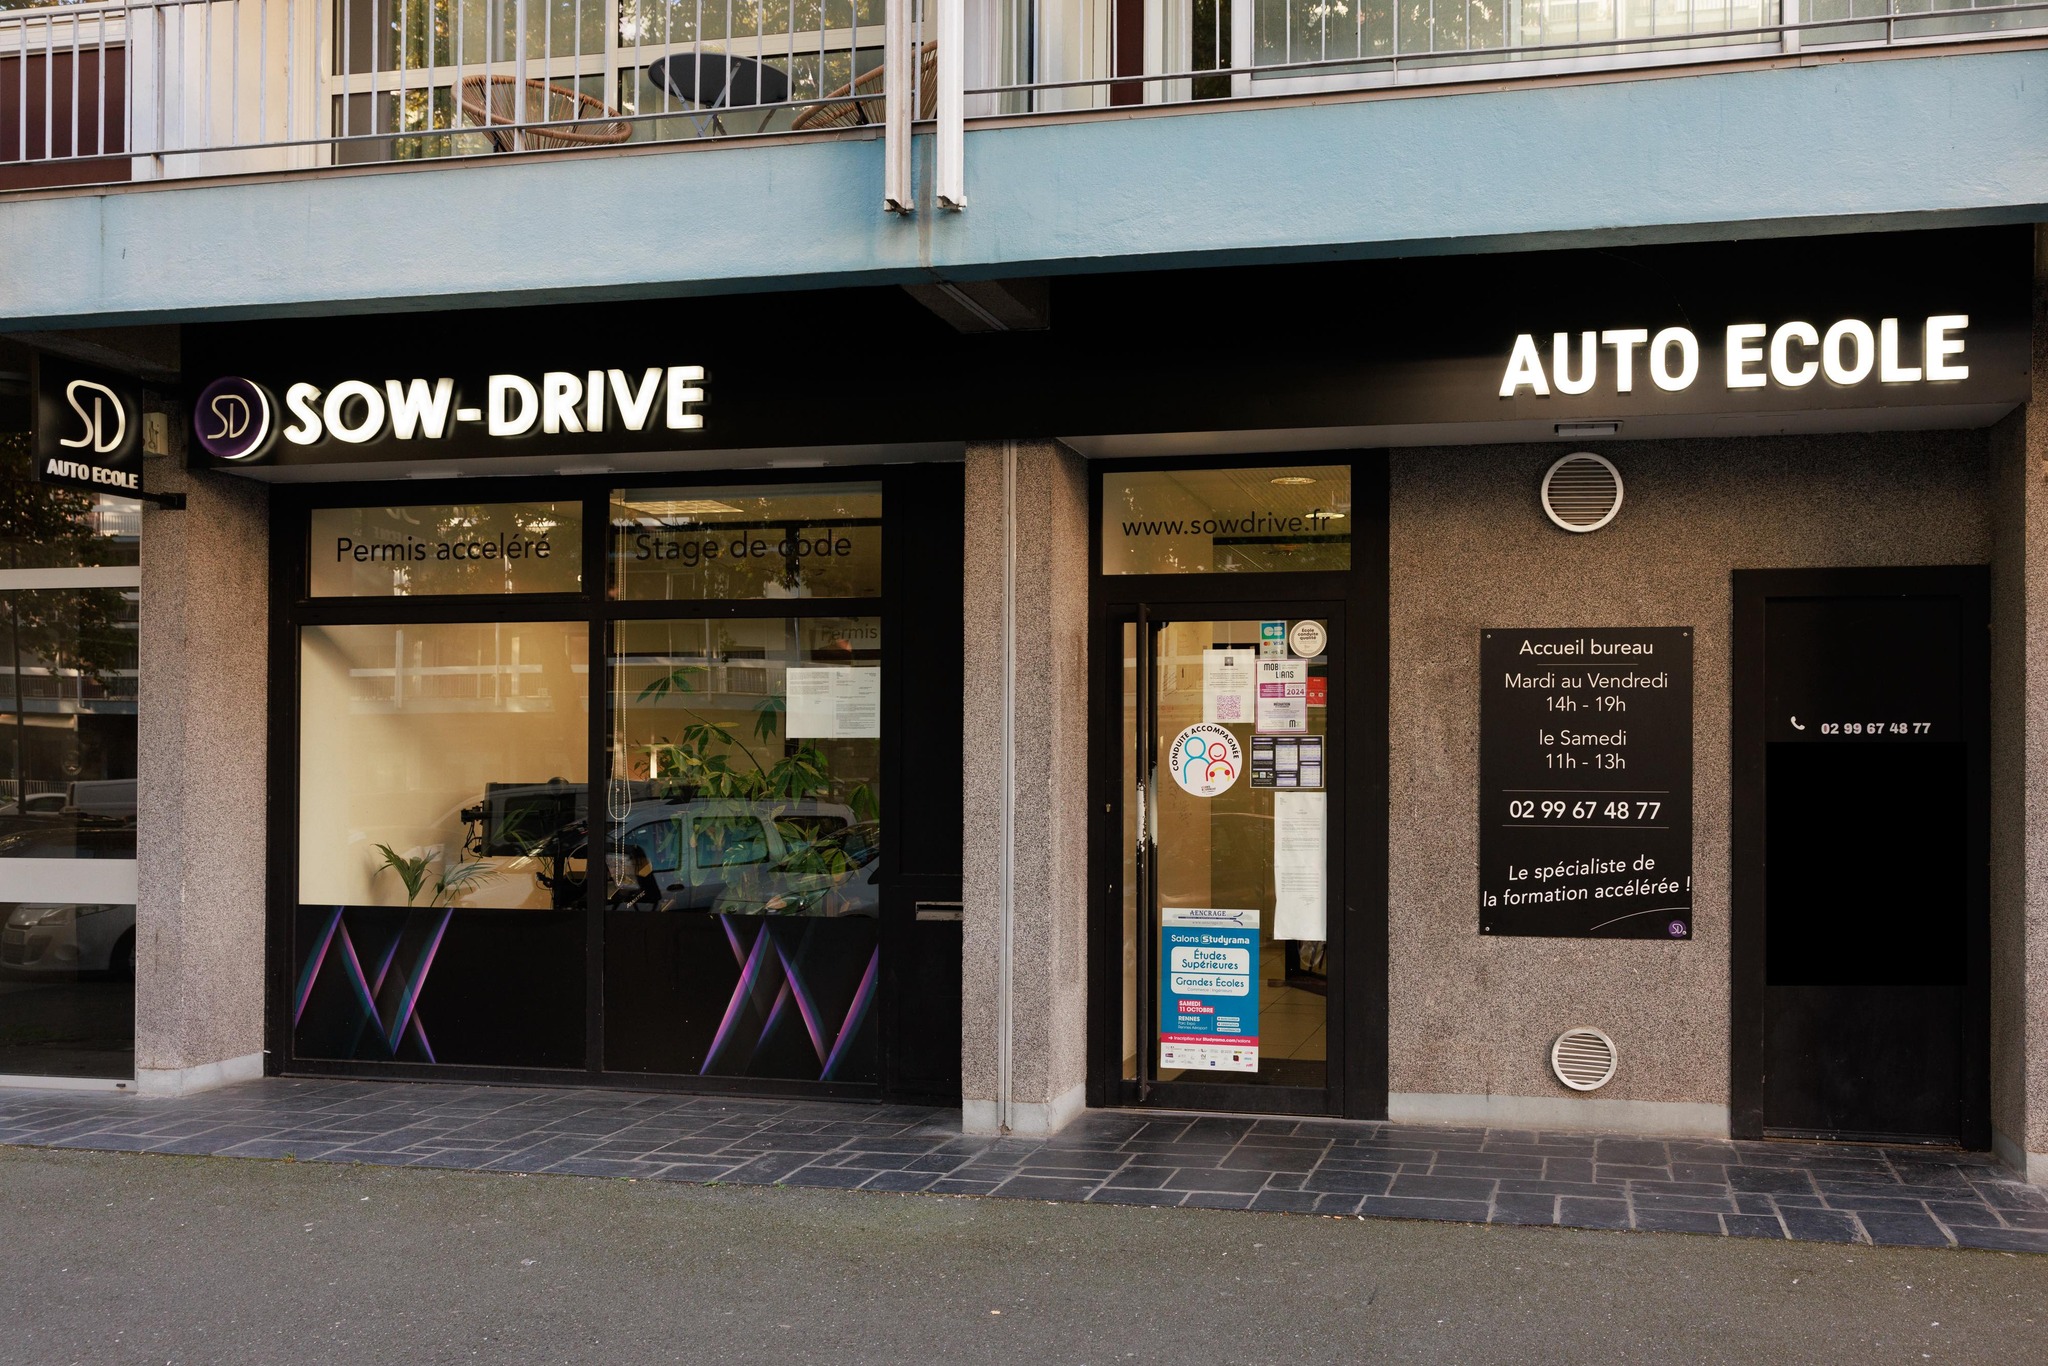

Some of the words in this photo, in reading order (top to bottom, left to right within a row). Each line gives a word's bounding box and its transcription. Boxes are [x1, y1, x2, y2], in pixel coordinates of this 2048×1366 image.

[1498, 327, 1700, 397] AUTO
[1725, 314, 1970, 389] ECOLE
[282, 366, 705, 446] SOW-DRIVE
[46, 458, 90, 481] AUTO
[92, 466, 139, 490] ECOLE
[1122, 508, 1331, 536] www.sowdrive.fr
[336, 536, 427, 562] Permis
[436, 532, 551, 560] acceléré
[635, 532, 719, 567] Stage
[729, 530, 767, 558] de
[777, 528, 852, 557] code
[821, 624, 878, 641] Permis
[1519, 639, 1584, 655] Accueil
[1590, 639, 1654, 655] bureau
[1505, 672, 1555, 688] Mardi
[1561, 676, 1582, 689] au
[1587, 672, 1668, 689] Vendredi
[1546, 696, 1577, 712] 14h
[1595, 696, 1626, 712] 19h
[1821, 723, 1839, 734] 02
[1843, 723, 1862, 734] 99
[1866, 723, 1885, 734] 67
[1889, 722, 1908, 734] 48
[1913, 722, 1931, 734] 77
[1539, 729, 1554, 746] le
[1560, 729, 1627, 746] Samedi
[1172, 732, 1190, 771] CONDUITE
[1191, 725, 1240, 760] ACCOMPAGNÉE
[1545, 753, 1576, 769] 11h
[1595, 753, 1626, 770] 13h
[1509, 800, 1535, 819] 02
[1540, 800, 1566, 819] 99
[1572, 801, 1597, 819] 67
[1604, 801, 1629, 820] 48
[1636, 802, 1661, 820] 77
[1508, 865, 1529, 881] Le
[1534, 857, 1627, 883] spécialiste
[1632, 854, 1656, 872] de
[1483, 891, 1498, 907] la
[1503, 885, 1589, 906] formation
[1594, 877, 1680, 899] accélérée
[1685, 876, 1691, 892] !
[1171, 934, 1199, 943] Salons
[1201, 934, 1250, 946] Studyrama
[1193, 948, 1227, 960] Études
[1181, 959, 1239, 970] Supérieures
[1176, 977, 1213, 987] Grandes
[1215, 977, 1245, 988] Écoles
